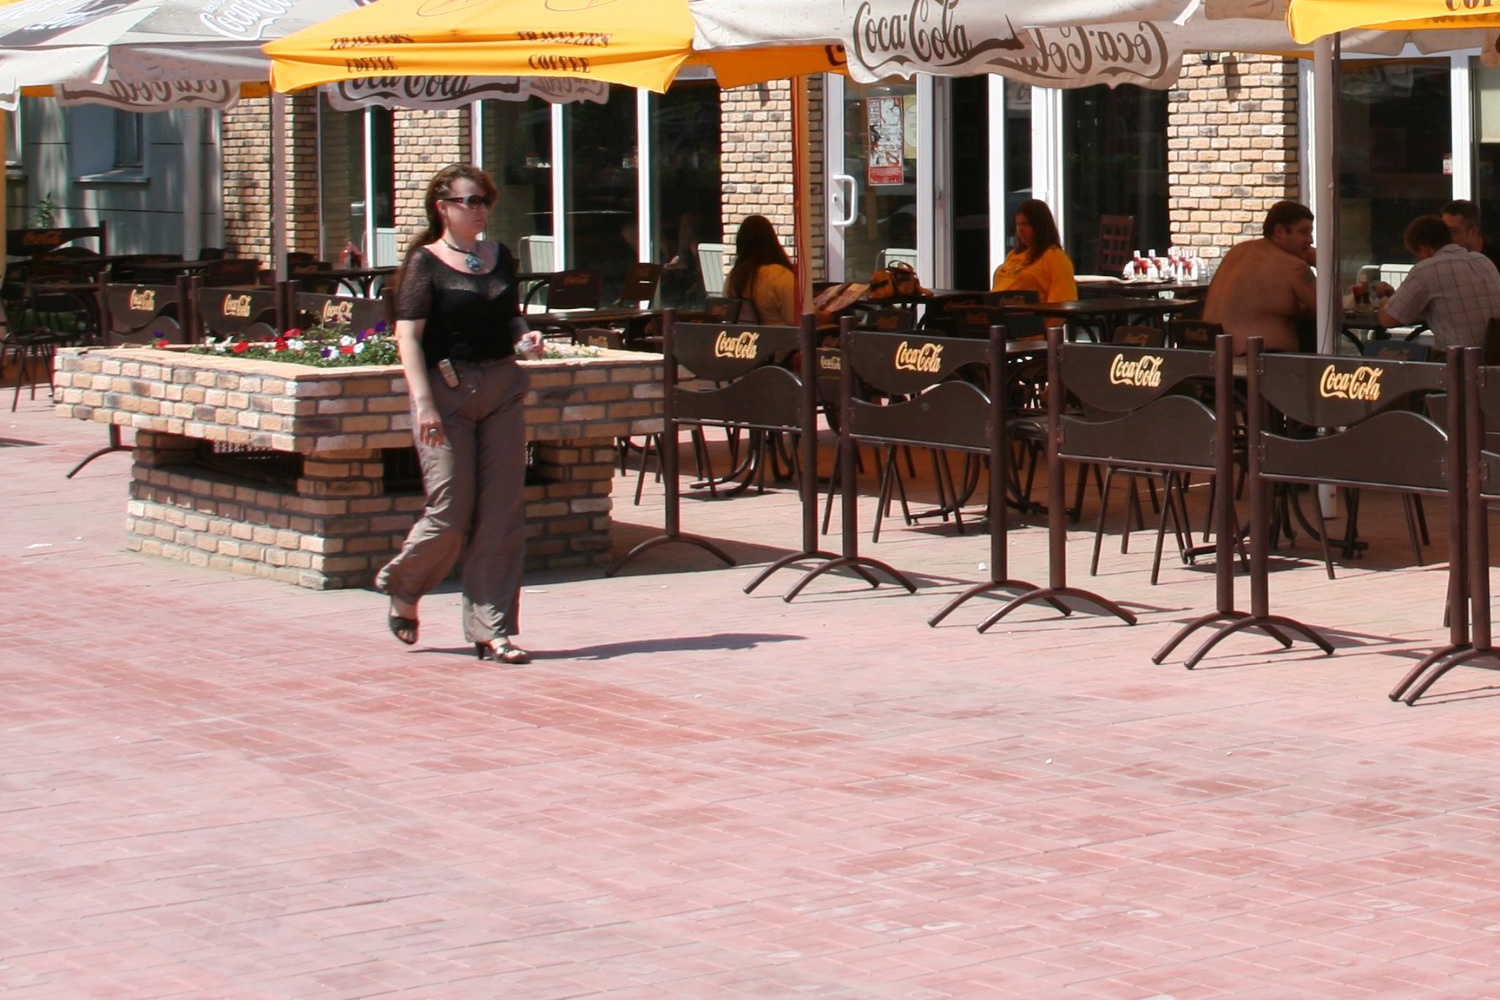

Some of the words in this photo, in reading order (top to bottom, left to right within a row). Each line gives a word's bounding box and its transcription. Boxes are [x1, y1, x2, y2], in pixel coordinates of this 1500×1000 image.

[528, 54, 591, 73] COFFEE
[715, 330, 758, 359] Coca-Cola
[895, 340, 944, 373] Coca-Cola
[1110, 353, 1163, 388] Coca-Cola
[1320, 364, 1383, 401] Coca-Cola
